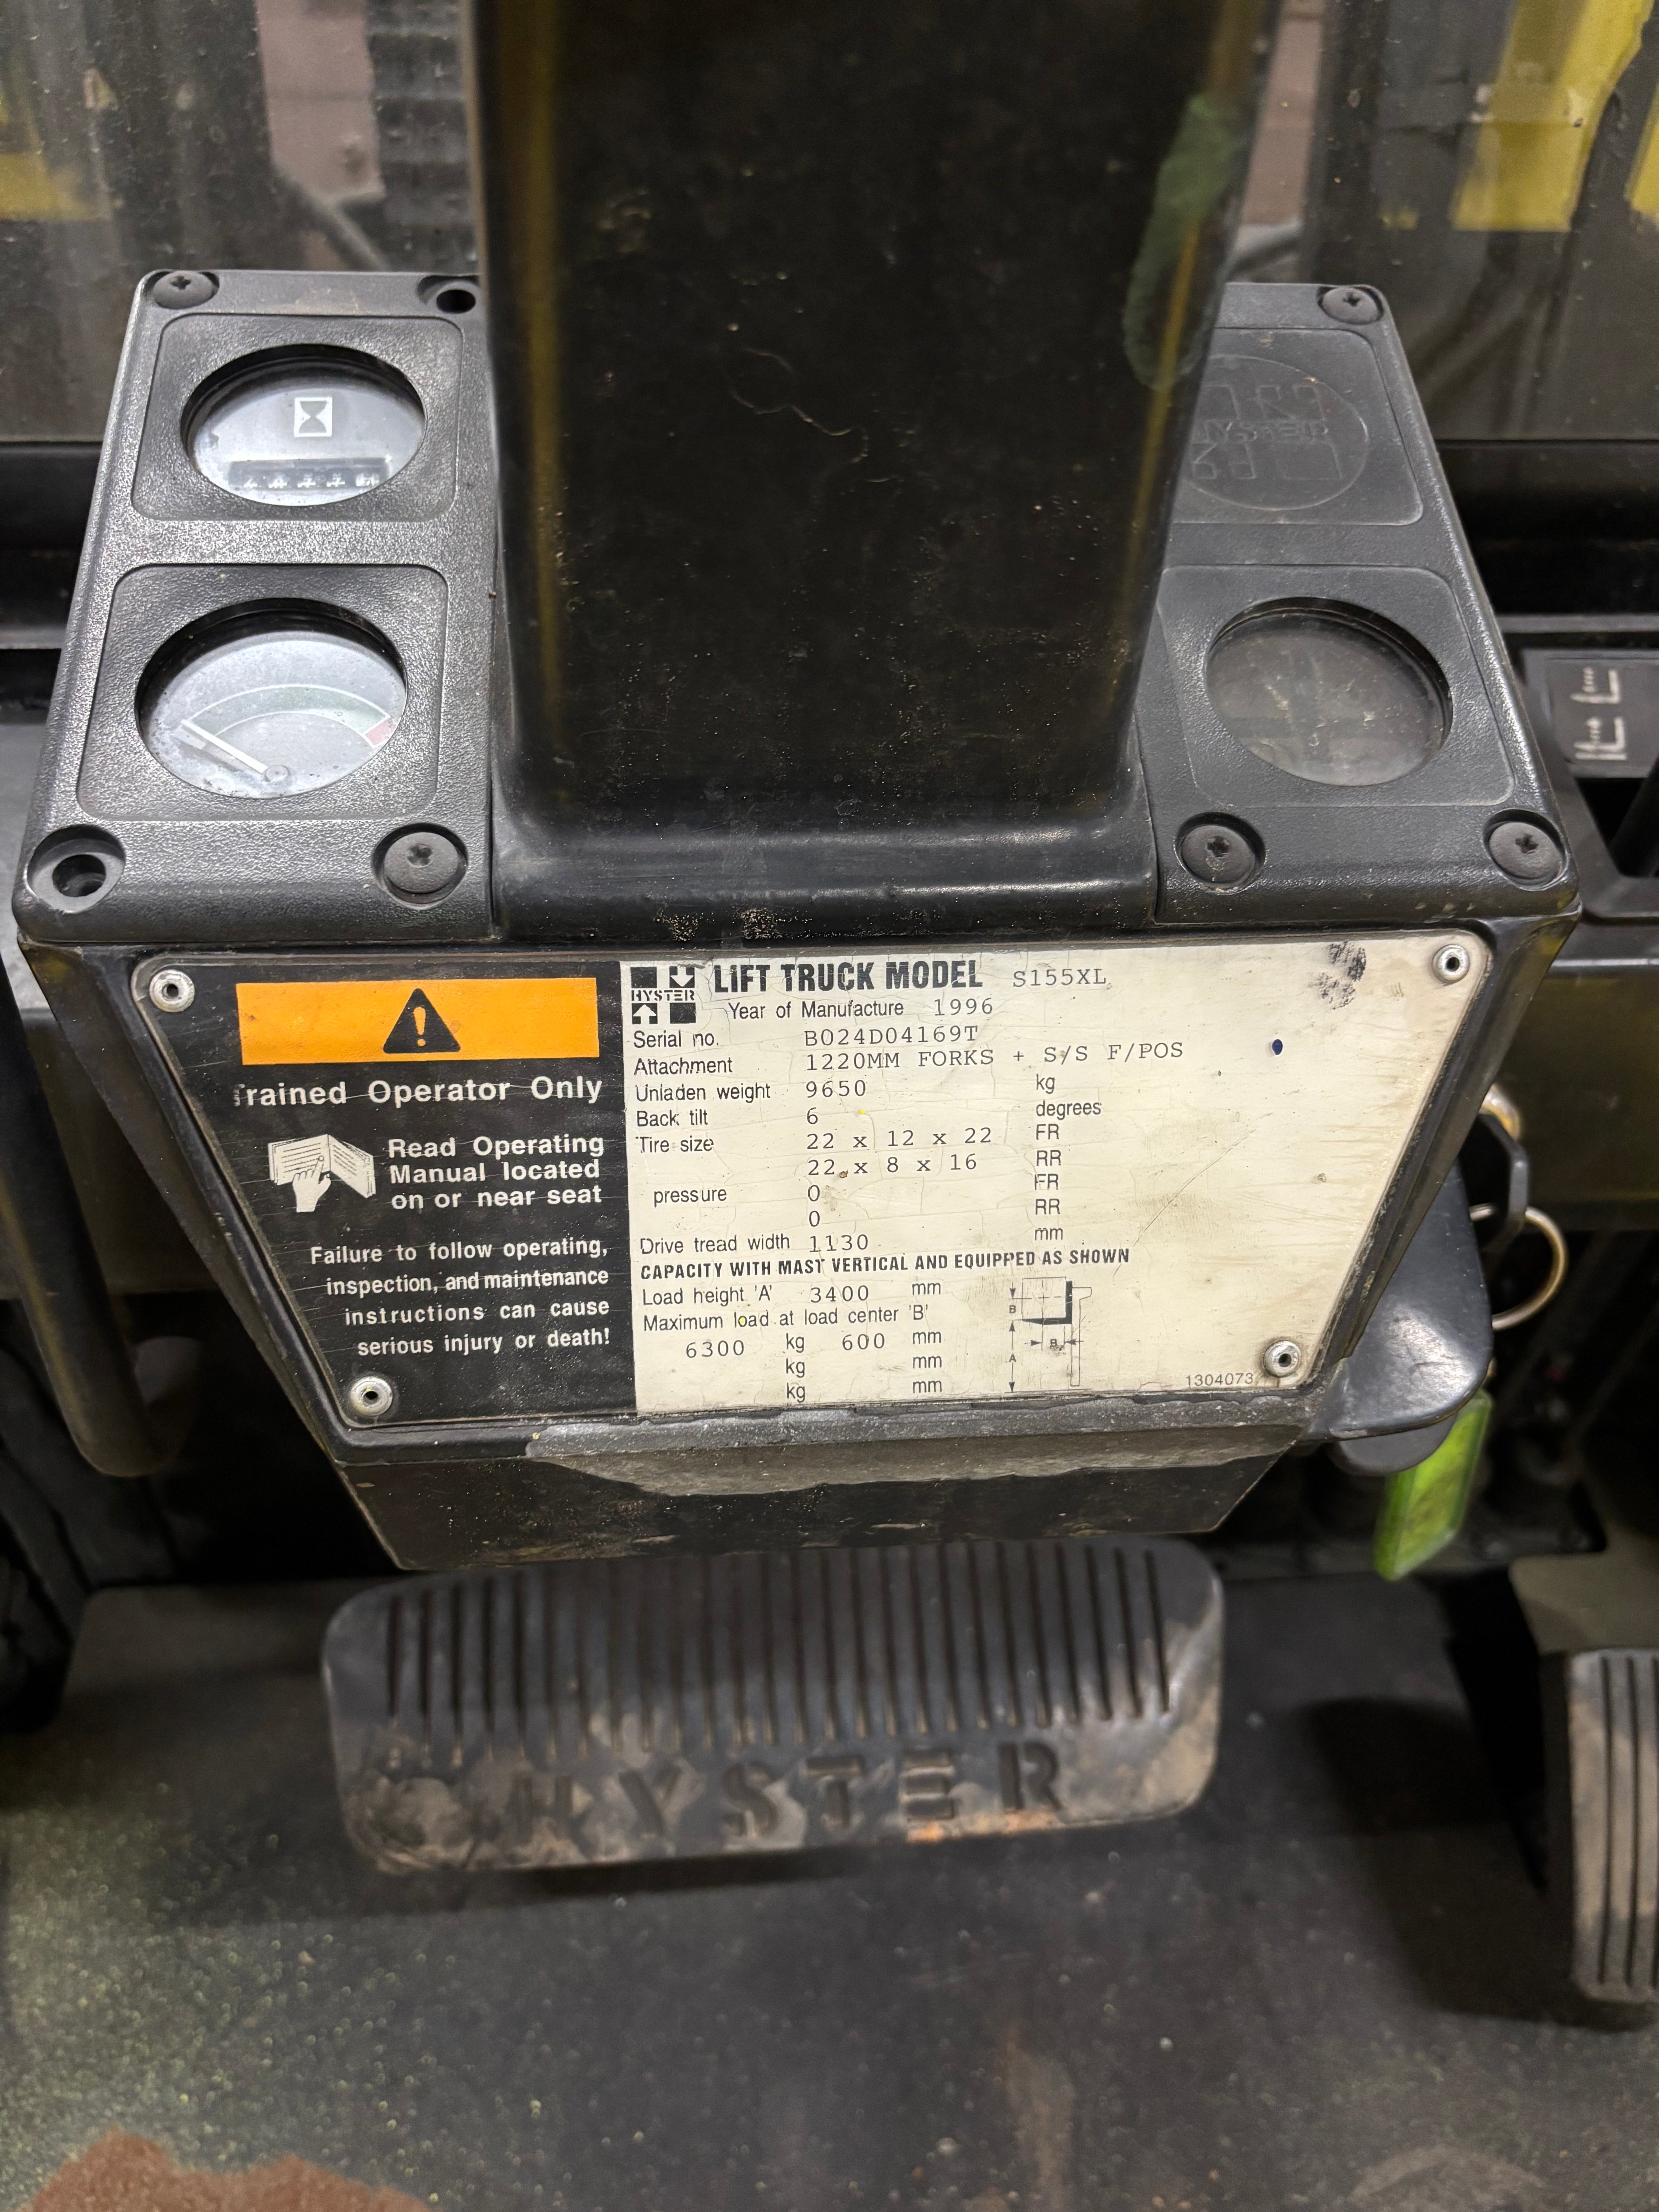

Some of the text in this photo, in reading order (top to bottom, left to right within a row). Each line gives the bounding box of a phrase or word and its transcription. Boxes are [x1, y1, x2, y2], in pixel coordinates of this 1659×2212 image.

[714, 960, 1106, 993] LIFT TRUCK MODEL S155XL
[631, 989, 695, 1001] HYSTER
[728, 998, 993, 1019] Year of Manufacture 1996
[634, 1026, 978, 1048] Serial no. B024D04169T
[634, 1042, 1183, 1074] Attachment 1220MM FORKS + S/S F/POS
[368, 1079, 510, 1108] Operator
[531, 1076, 602, 1103] Only
[636, 1074, 1055, 1103] Unladen weight 9650 kg
[636, 1102, 1102, 1127] Back tilt 6 degrees
[389, 1134, 604, 1158] Read Operating
[636, 1124, 1059, 1153] Tire size 22 x 12 x 22 FR
[390, 1160, 600, 1184] Manual located
[808, 1150, 1061, 1176] 22 x 8 x 16 RR
[392, 1185, 602, 1209] on or near seat
[654, 1187, 727, 1207] pressure
[1035, 1174, 1058, 1190] FR
[1036, 1199, 1060, 1215] RR
[311, 1238, 607, 1265] Failure to follow operating,
[641, 1228, 1063, 1254] Drive tread width 1130 mm
[641, 1249, 1130, 1279] CAPACITY WITH MAST VERTICAL AND EQUIPPED AS SHOWN
[326, 1269, 609, 1297] inspection, and maintenance
[642, 1289, 683, 1305] Load
[694, 1288, 744, 1306] height
[811, 1285, 869, 1303] 3400
[912, 1281, 941, 1295] mm
[345, 1300, 610, 1325] instructions can cause
[644, 1315, 723, 1331] Maximum
[735, 1310, 769, 1327] load
[779, 1311, 794, 1325] at
[805, 1309, 837, 1325] load
[849, 1308, 899, 1323] center
[1009, 1305, 1016, 1313] B
[358, 1328, 610, 1356] serious injury or death!
[686, 1331, 941, 1358] 6300 kg 600 mm
[785, 1355, 942, 1378] kg mm
[1009, 1354, 1016, 1362] A
[786, 1380, 942, 1402] kg mm
[1186, 1373, 1254, 1386] 1304073
